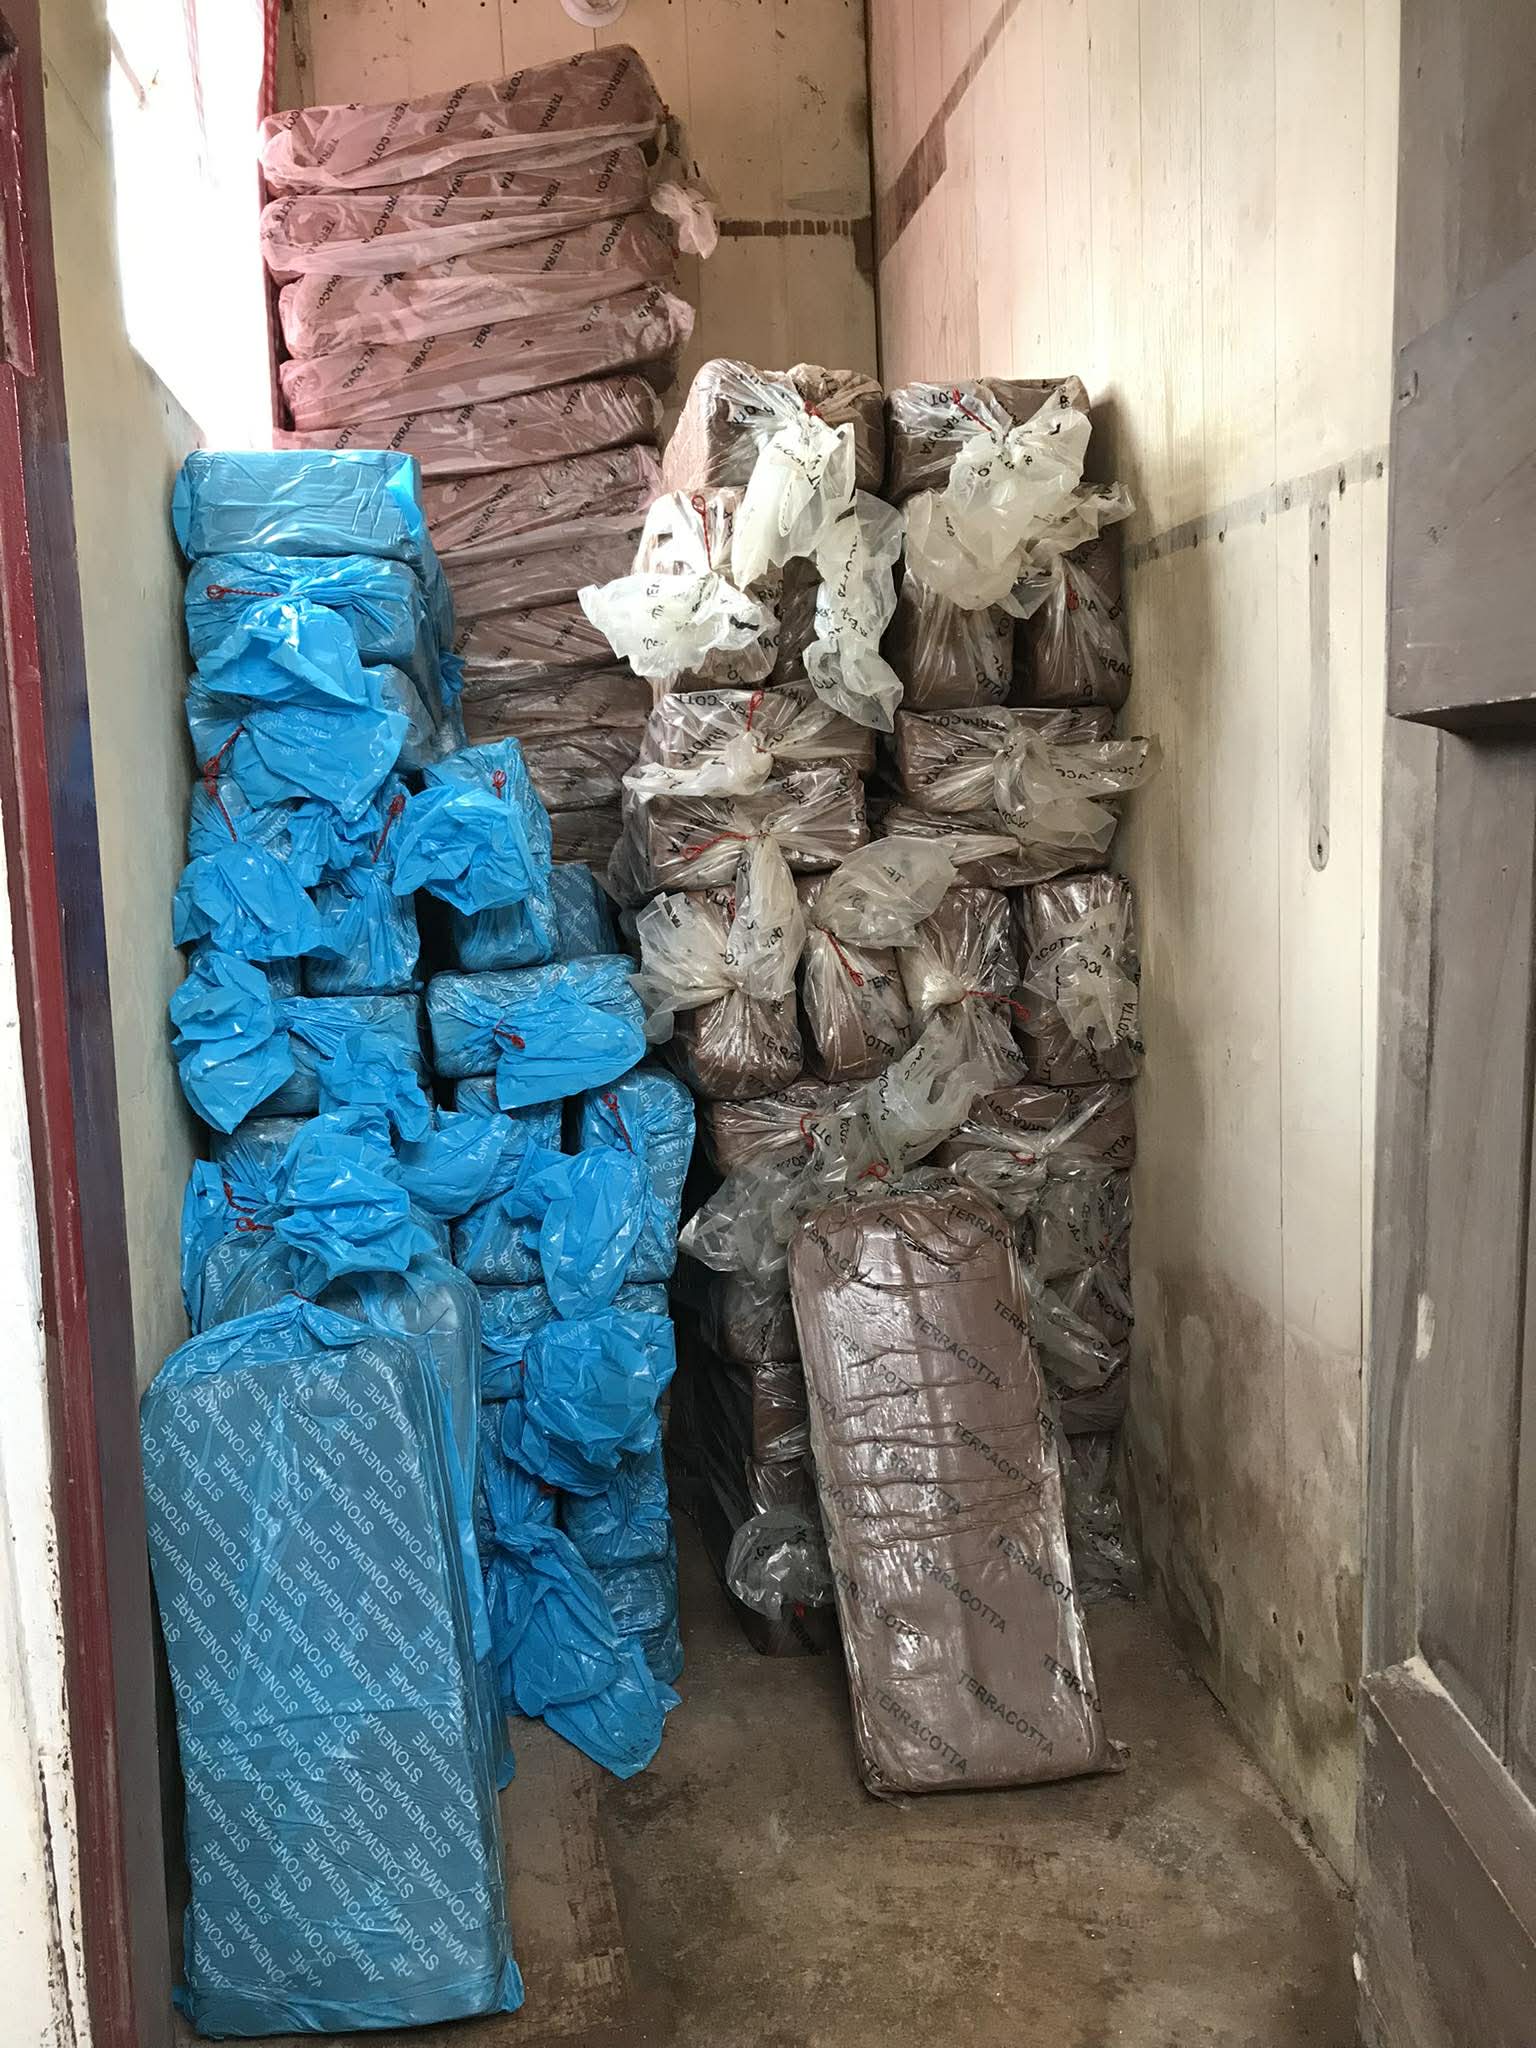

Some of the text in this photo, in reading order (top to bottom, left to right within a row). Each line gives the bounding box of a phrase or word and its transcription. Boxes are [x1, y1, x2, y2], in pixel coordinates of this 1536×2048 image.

[342, 347, 380, 389] RACOTTA
[914, 1312, 1001, 1389] TERRACOTTA
[190, 1385, 255, 1466] STONEWARE
[248, 1419, 312, 1500] STONEWARE
[332, 1418, 406, 1498] STONEWARE
[953, 1422, 1041, 1500] TERRACOTTA
[180, 1488, 247, 1571] STONEWARE
[214, 1453, 280, 1536] STONEWARE
[270, 1488, 340, 1569] STONEWARE
[302, 1453, 373, 1534] STONEWARE
[362, 1485, 434, 1569] STONEWARE
[147, 1523, 215, 1607] STONEWARE
[239, 1527, 306, 1606] STONEWARE
[296, 1557, 368, 1641] STONEWARE
[329, 1521, 401, 1604] STONEWARE
[913, 1551, 1007, 1634] TERRACOTTA
[997, 1534, 1075, 1602] TERRACOT
[172, 1593, 238, 1680] STONEWARE
[261, 1592, 332, 1677] STONEWARE
[323, 1628, 394, 1710] STONEWARE
[356, 1591, 428, 1674] STONEWARE
[195, 1664, 262, 1747] STONEWARE
[871, 1686, 968, 1774] TERRACOTTA
[958, 1670, 1054, 1757] TERRACOTTA
[177, 1717, 226, 1781] STONEWA
[217, 1734, 286, 1818] STONEWARE
[185, 1768, 249, 1852] STONEWARE
[241, 1803, 311, 1891] STONEWARE
[276, 1768, 350, 1856] STONEWARE
[339, 1804, 413, 1898] STONEWARE
[376, 1767, 450, 1857] STONEWARE
[203, 1839, 272, 1924] STONEWARE
[302, 1838, 374, 1930] STONEWARE
[225, 1907, 297, 1992] TONEWARE
[365, 1881, 438, 1970] STONEWARE
